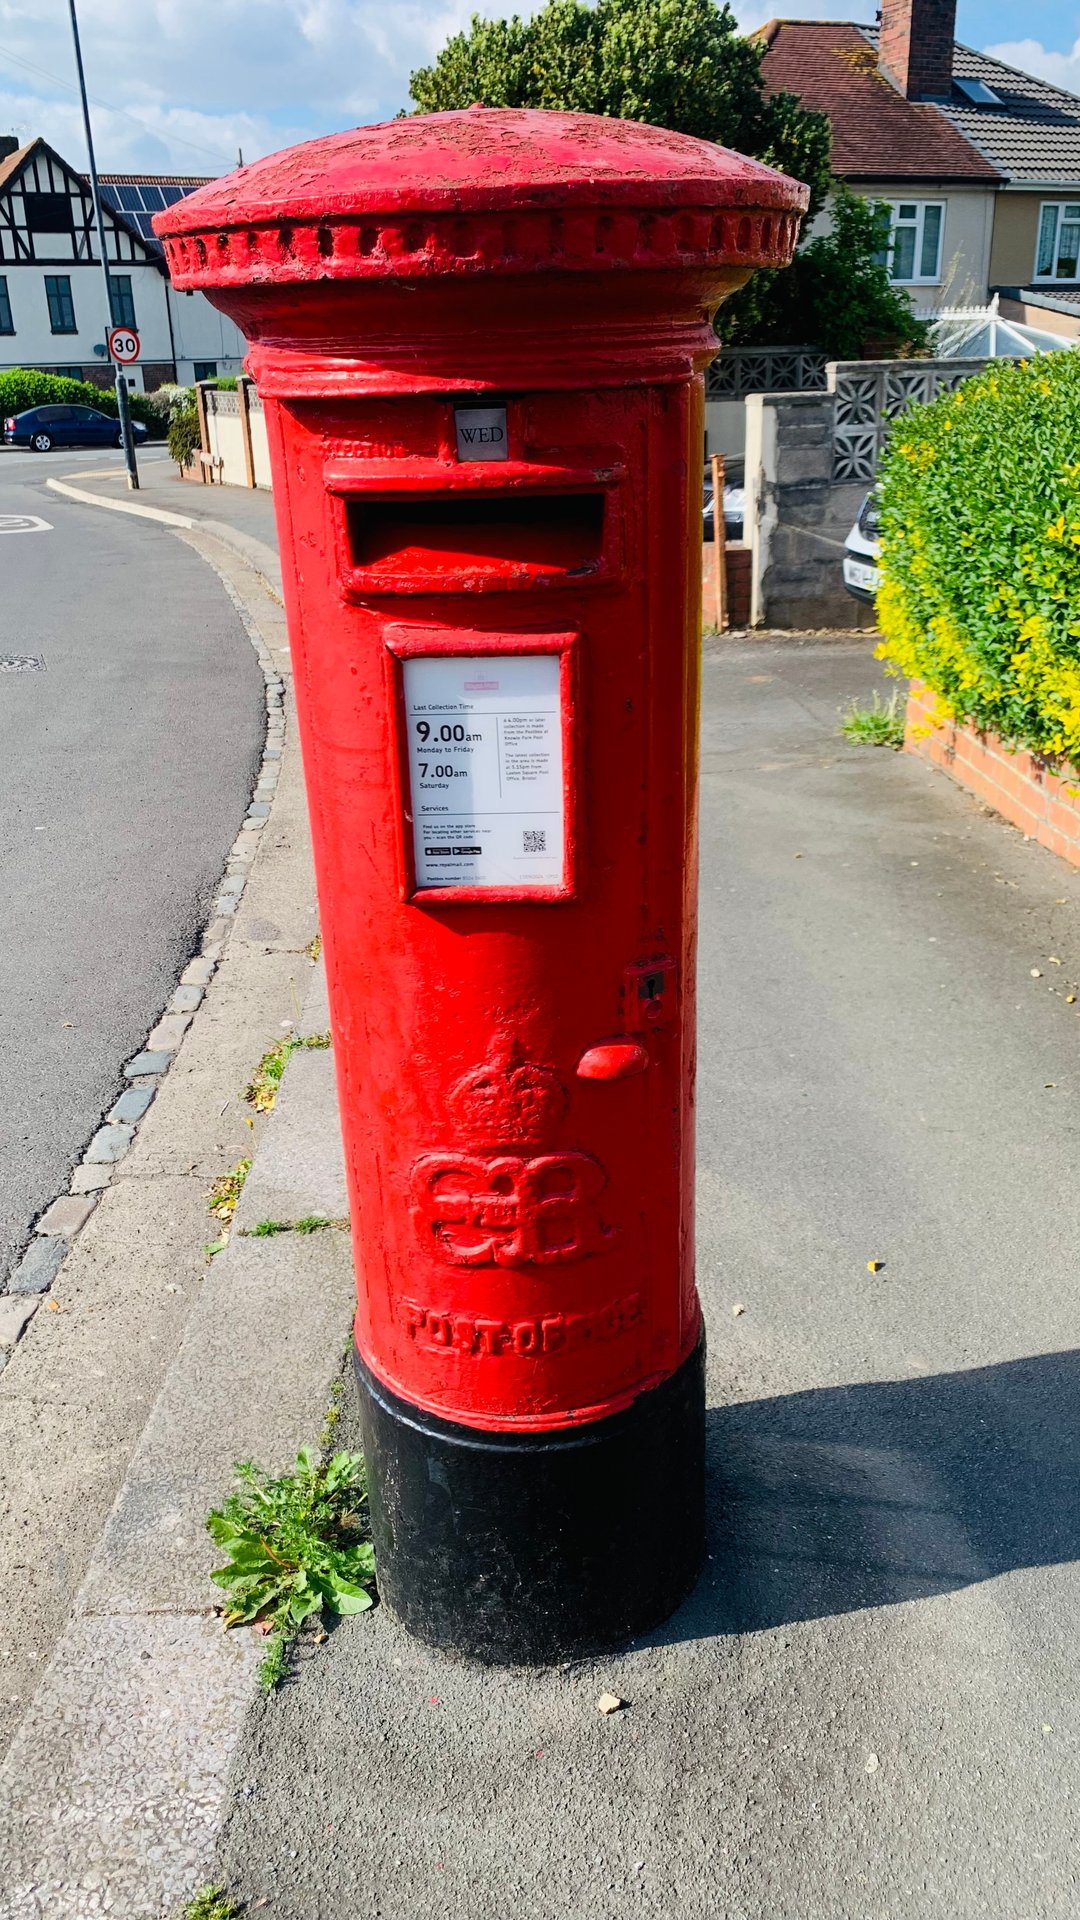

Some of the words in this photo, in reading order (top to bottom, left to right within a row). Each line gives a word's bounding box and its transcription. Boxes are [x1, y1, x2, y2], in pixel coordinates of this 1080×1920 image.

[114, 338, 136, 352] 30
[460, 426, 504, 444] WED
[416, 720, 482, 742] 9.00am
[418, 762, 468, 778] 7.00am
